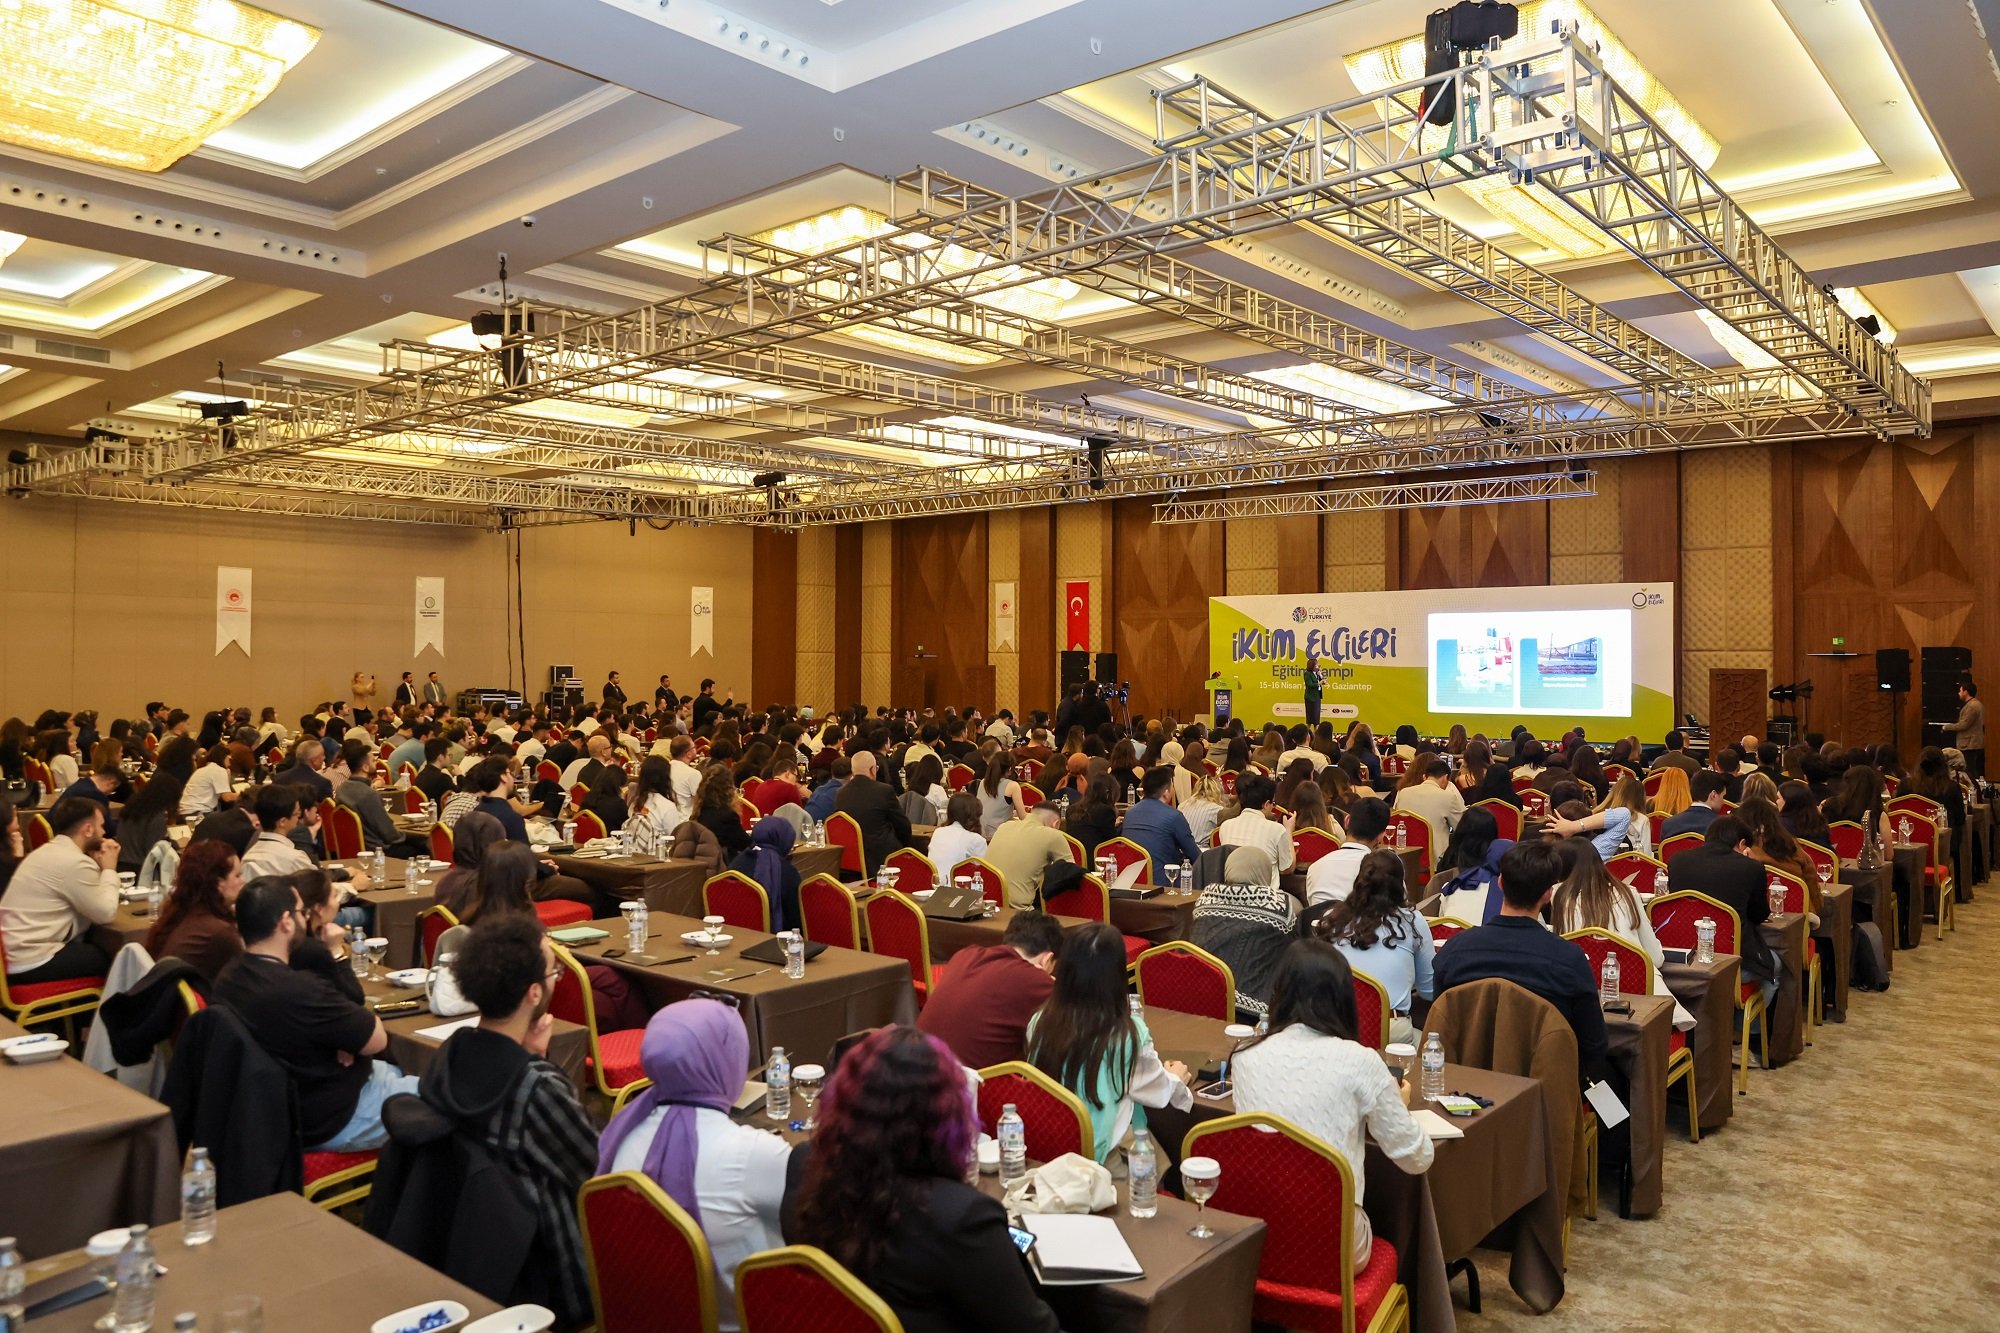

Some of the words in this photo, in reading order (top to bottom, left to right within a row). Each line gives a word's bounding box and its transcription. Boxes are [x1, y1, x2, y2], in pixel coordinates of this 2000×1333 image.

[1308, 606, 1332, 615] COP31
[1322, 667, 1354, 681] ampı
[1259, 681, 1280, 689] 15-16
[1280, 681, 1302, 690] Nisan
[1332, 682, 1372, 692] Gaziantep
